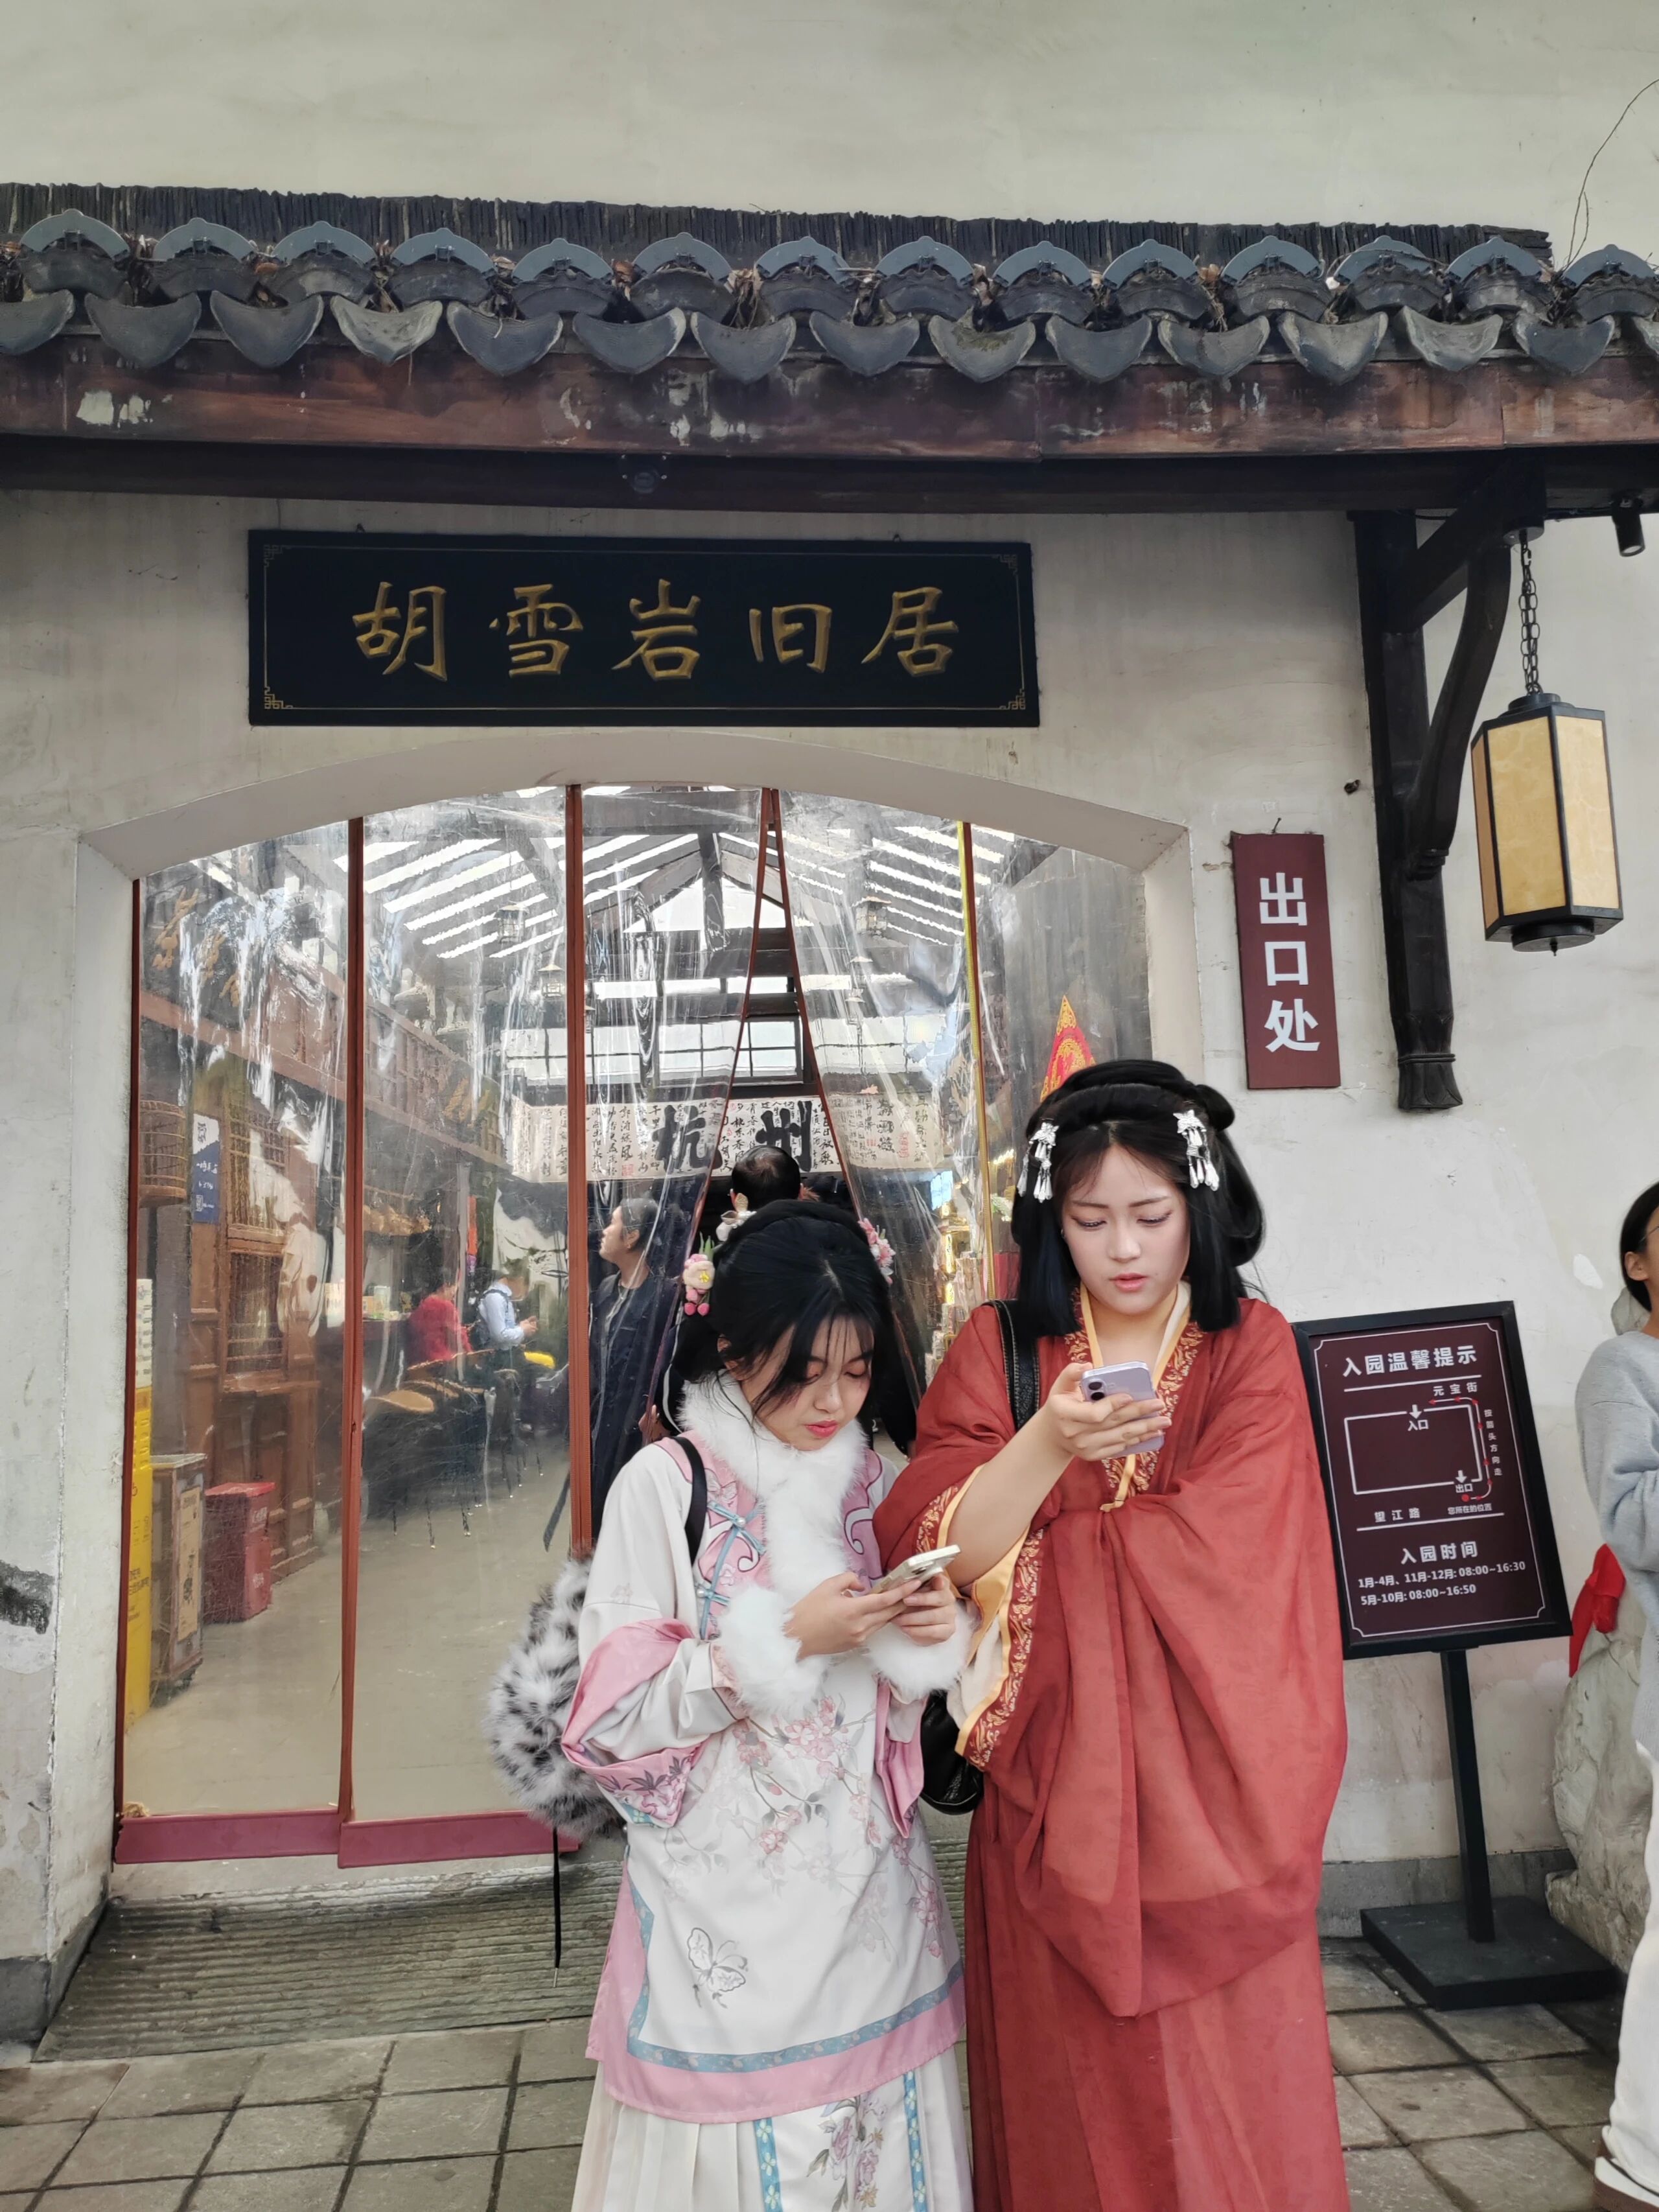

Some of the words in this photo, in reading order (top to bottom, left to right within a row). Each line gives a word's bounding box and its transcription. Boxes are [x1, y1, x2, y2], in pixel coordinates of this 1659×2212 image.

[352, 579, 958, 681] 胡雪岩旧居
[1259, 872, 1320, 1053] 出口处
[1343, 1345, 1477, 1377] 入园温馨提示
[1433, 1382, 1478, 1397] 元宝街
[1408, 1419, 1429, 1431] 入口
[1456, 1484, 1473, 1493] 出口
[1375, 1508, 1421, 1522] 望江路
[1447, 1503, 1492, 1515] 您所在的位置
[1400, 1541, 1478, 1565] 入园时间
